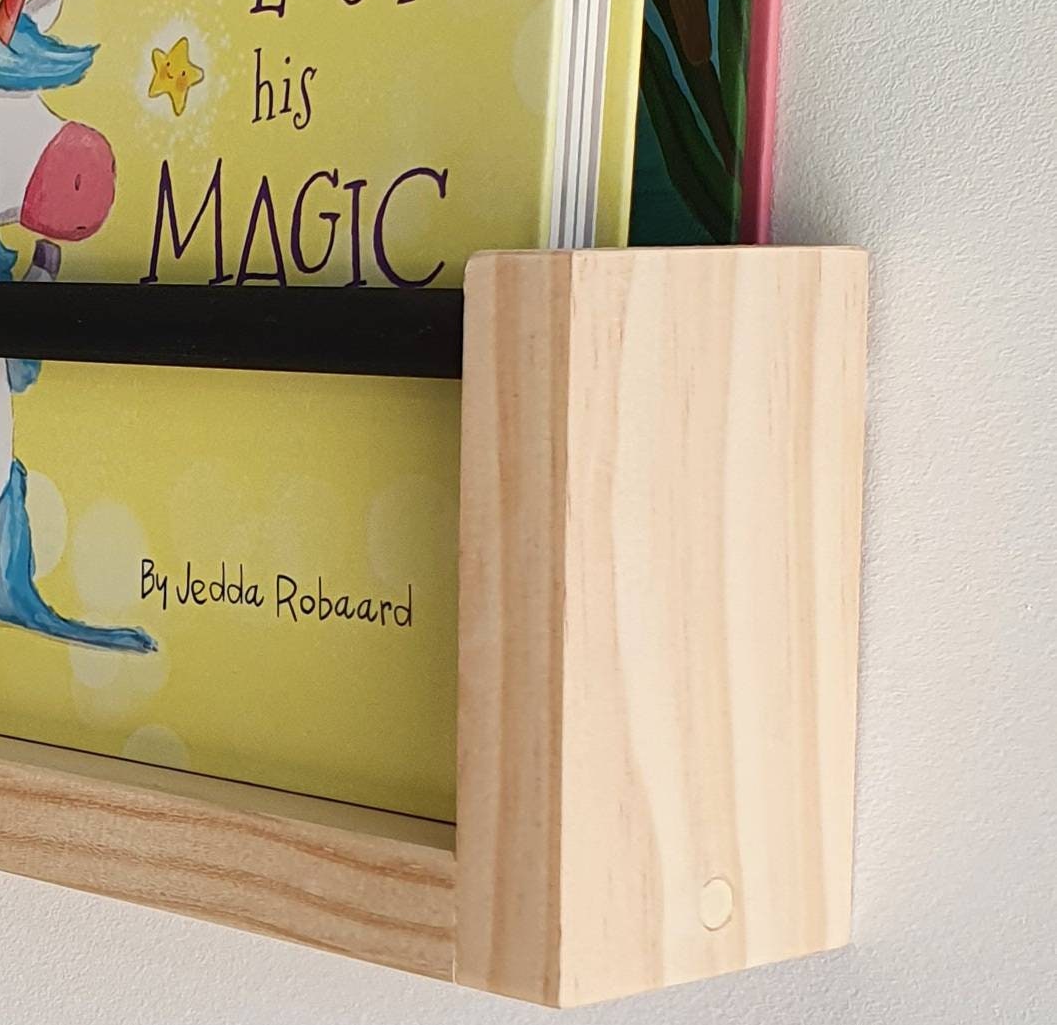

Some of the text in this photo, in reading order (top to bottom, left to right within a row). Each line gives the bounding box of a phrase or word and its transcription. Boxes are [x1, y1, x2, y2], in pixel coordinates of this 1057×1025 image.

[252, 48, 317, 130] his
[139, 157, 449, 288] MAGIC
[141, 558, 413, 627] By Jedda Robaard
